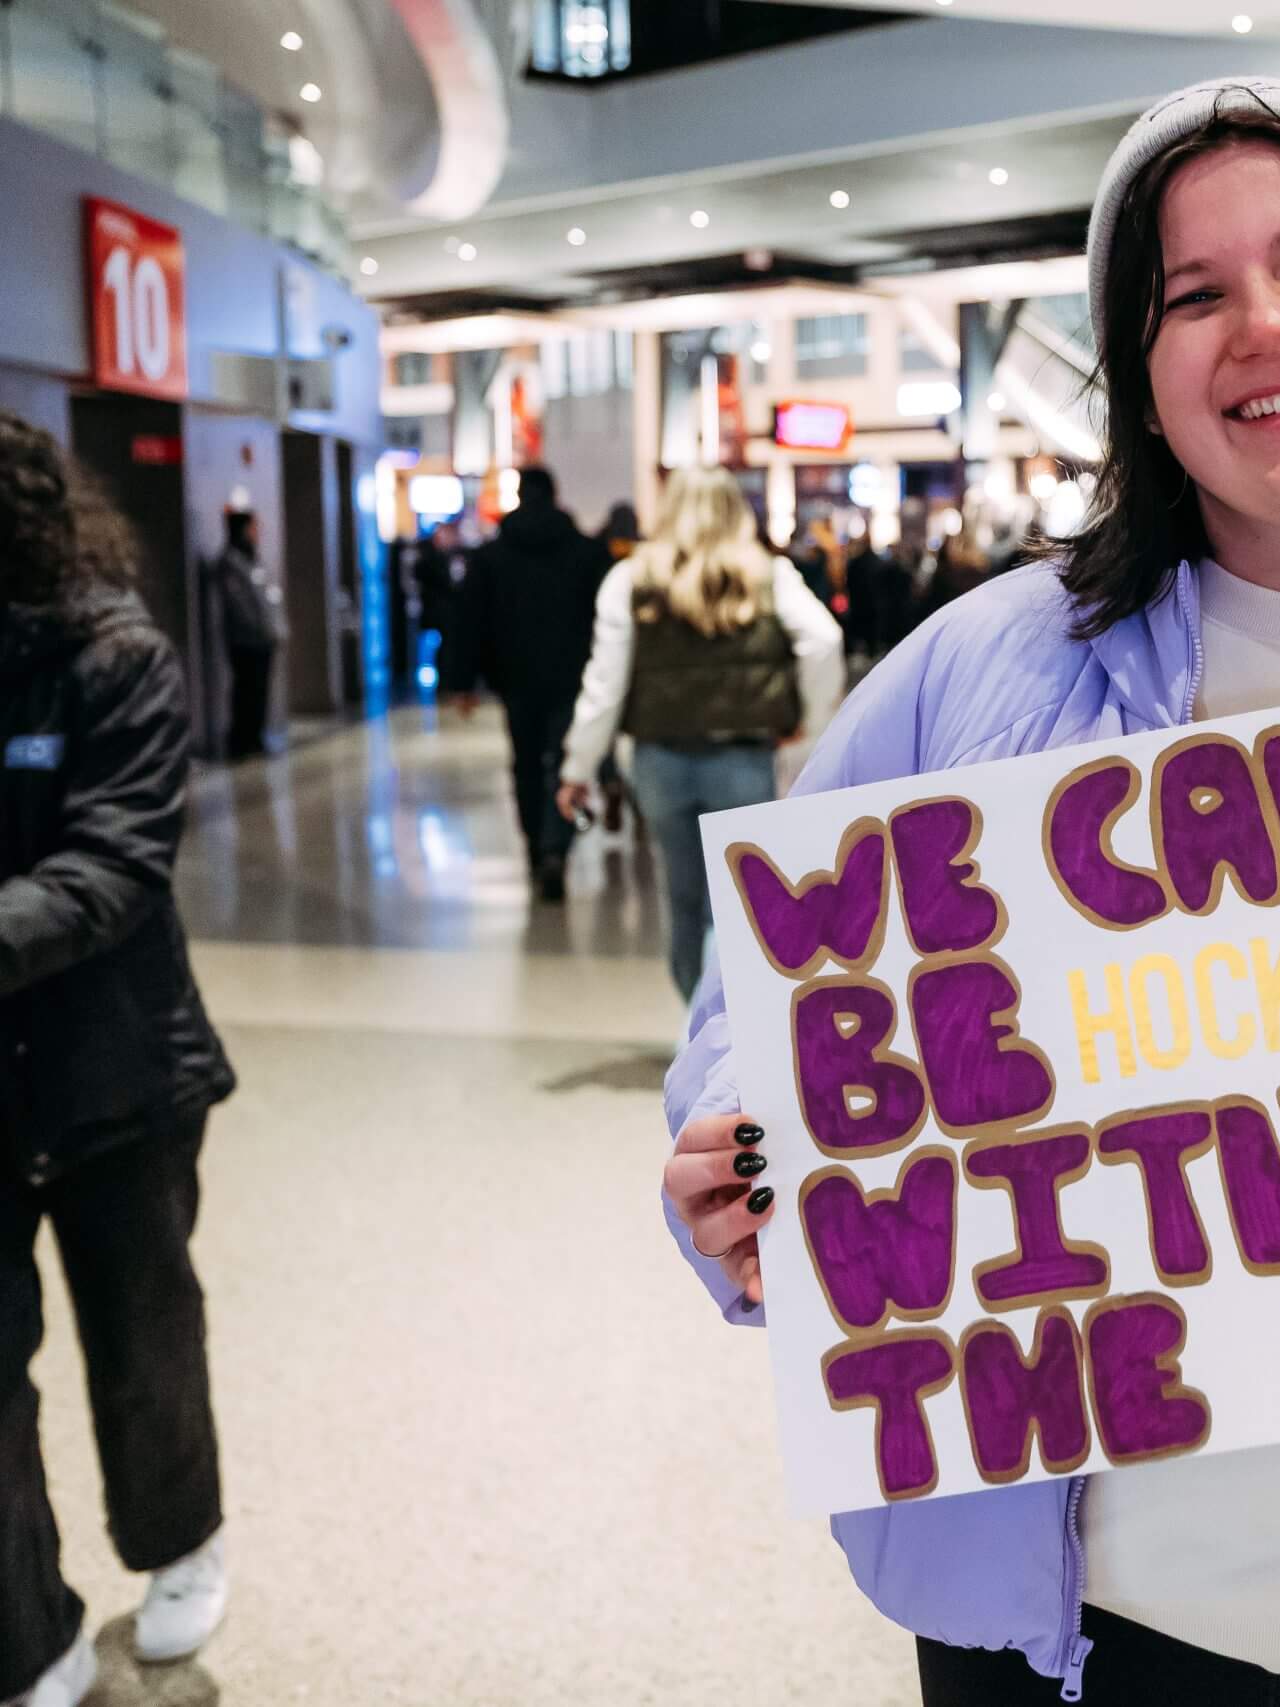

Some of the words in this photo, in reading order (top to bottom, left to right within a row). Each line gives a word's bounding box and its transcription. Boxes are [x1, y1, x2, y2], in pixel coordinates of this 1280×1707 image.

[104, 246, 169, 380] 10
[725, 796, 1009, 979] WE
[790, 952, 1056, 1157] BE
[823, 1292, 1212, 1501] THE
